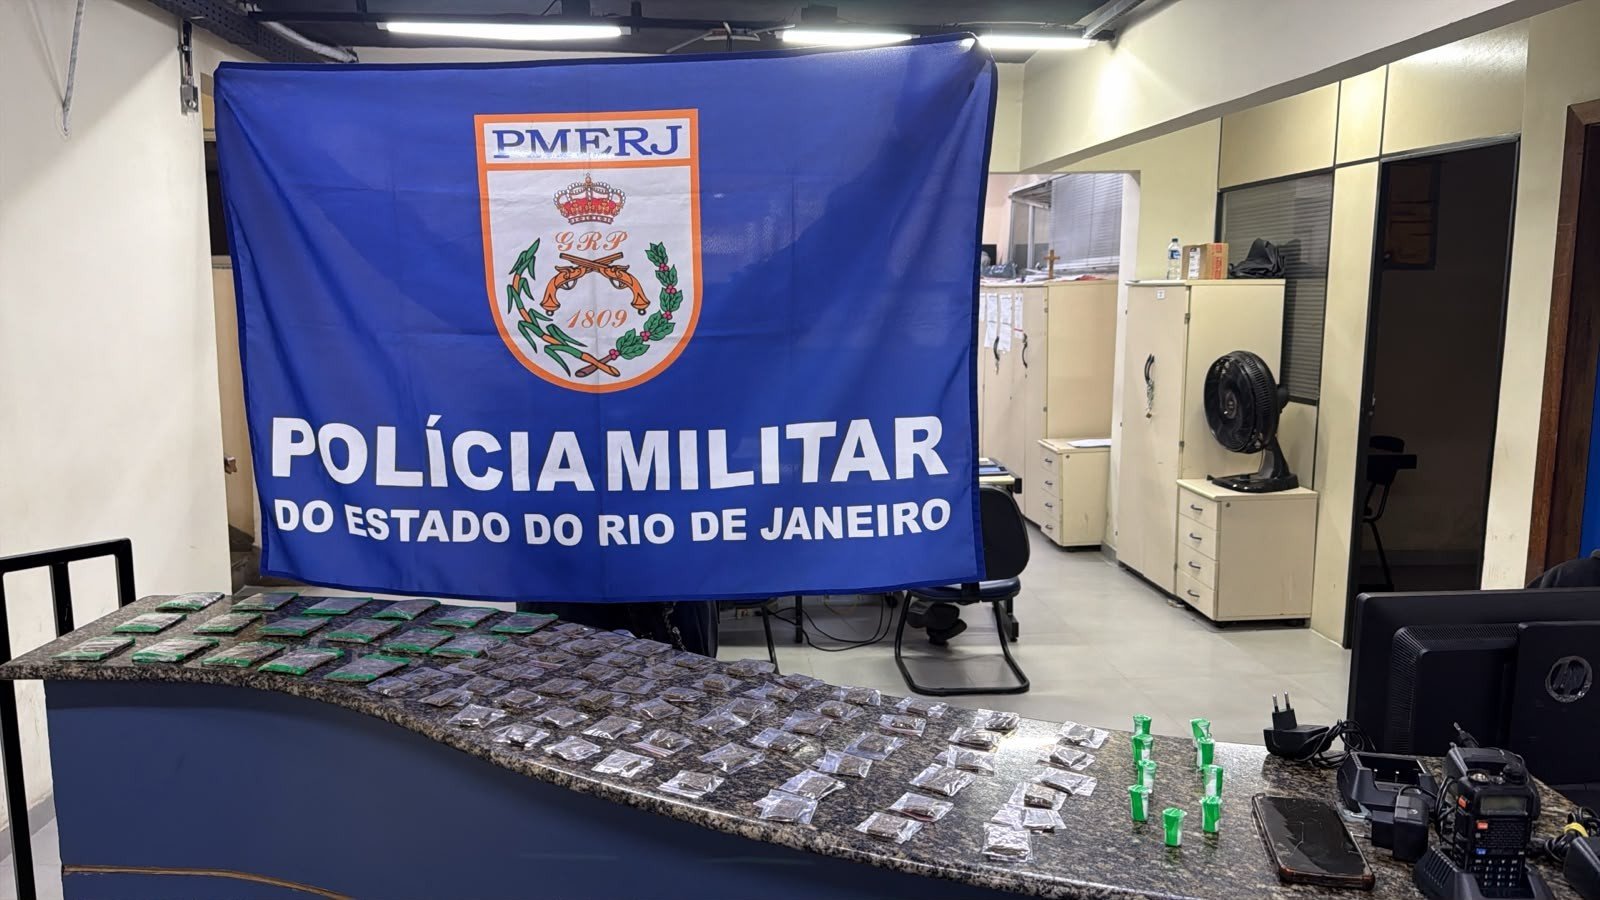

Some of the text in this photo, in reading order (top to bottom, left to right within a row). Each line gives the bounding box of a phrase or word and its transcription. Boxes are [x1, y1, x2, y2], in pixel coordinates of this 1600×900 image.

[492, 125, 682, 158] PMERJ
[554, 231, 628, 251] GRP
[567, 308, 628, 329] 1809
[272, 414, 949, 491] POLÍCIA MILITAR
[274, 498, 951, 546] DO ESTADO DO RIO DE JANEIRO
